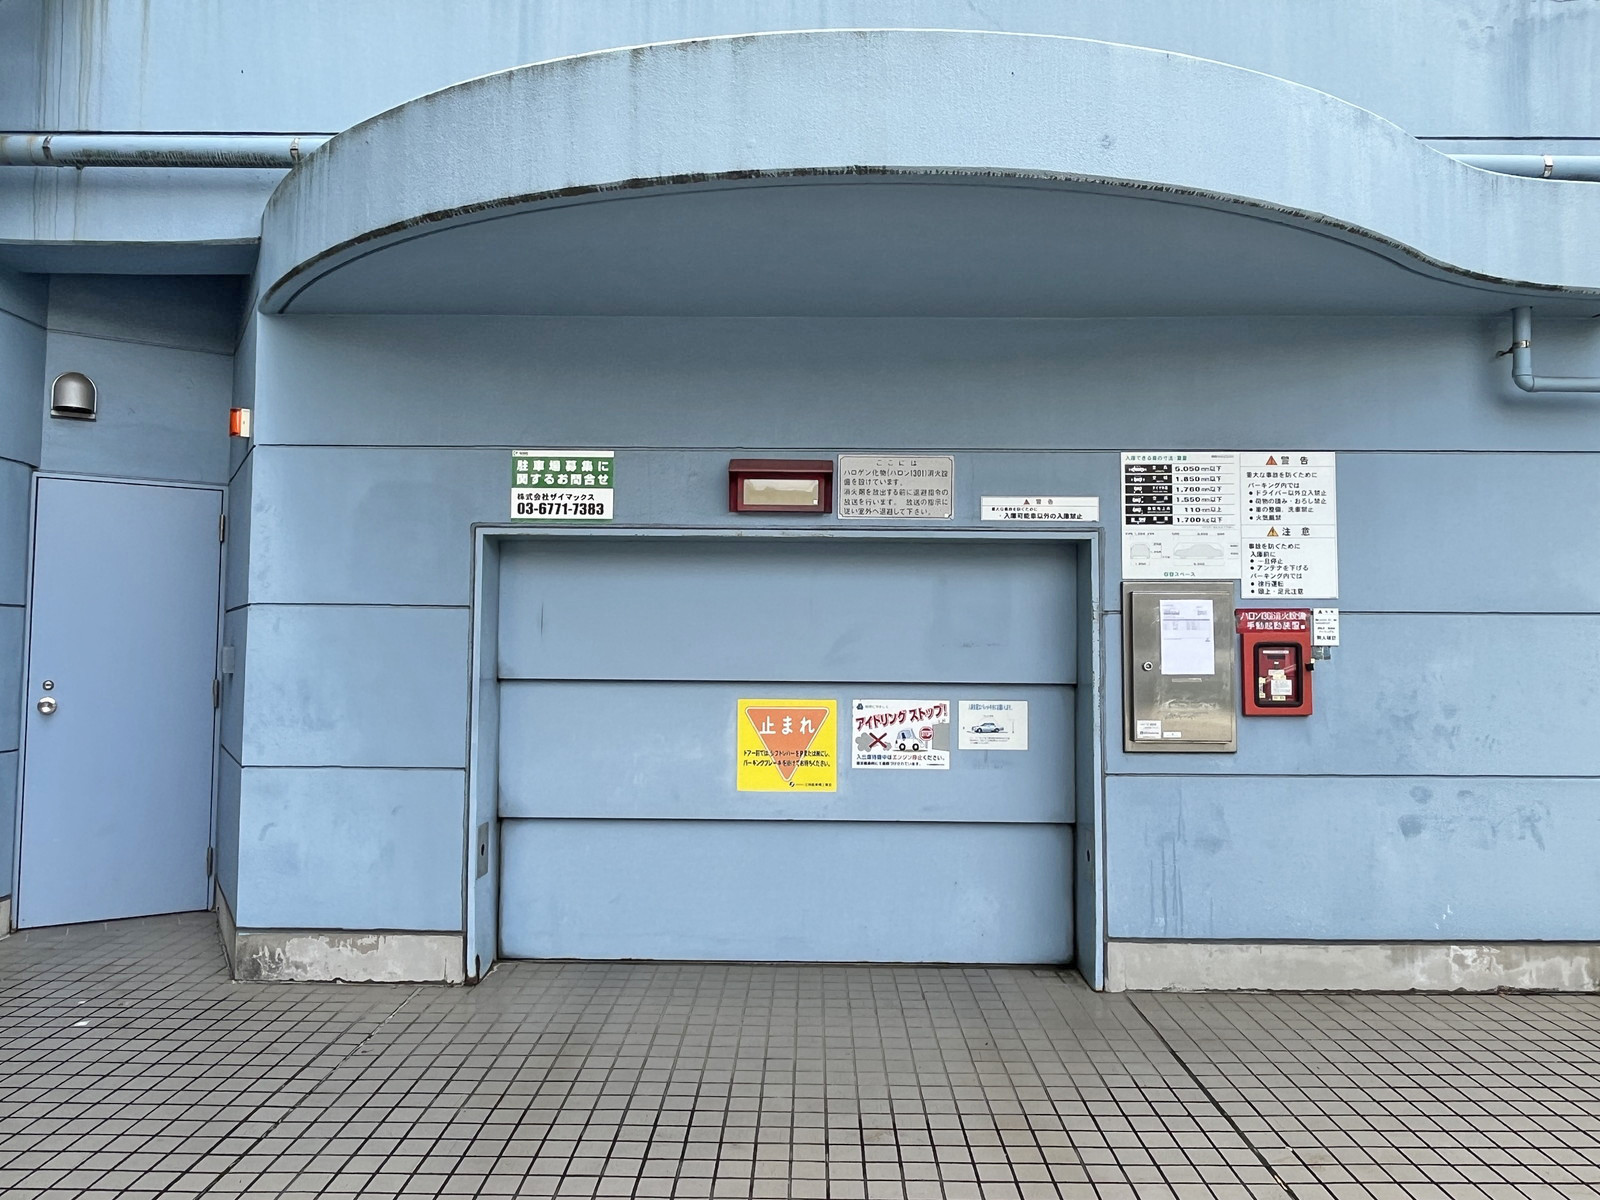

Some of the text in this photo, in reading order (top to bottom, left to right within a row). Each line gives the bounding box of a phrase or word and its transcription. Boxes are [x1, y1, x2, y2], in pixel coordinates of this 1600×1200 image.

[516, 459, 609, 471] 駐車場募集に
[1280, 455, 1309, 465] 警告
[516, 473, 609, 485] 関するお問合せ
[517, 493, 594, 501] 株式会社ザイマックス
[517, 502, 604, 515] 03-6771-7383
[1282, 526, 1310, 536] 注意
[759, 715, 816, 735] 止まれ
[855, 709, 907, 731] アイドリング
